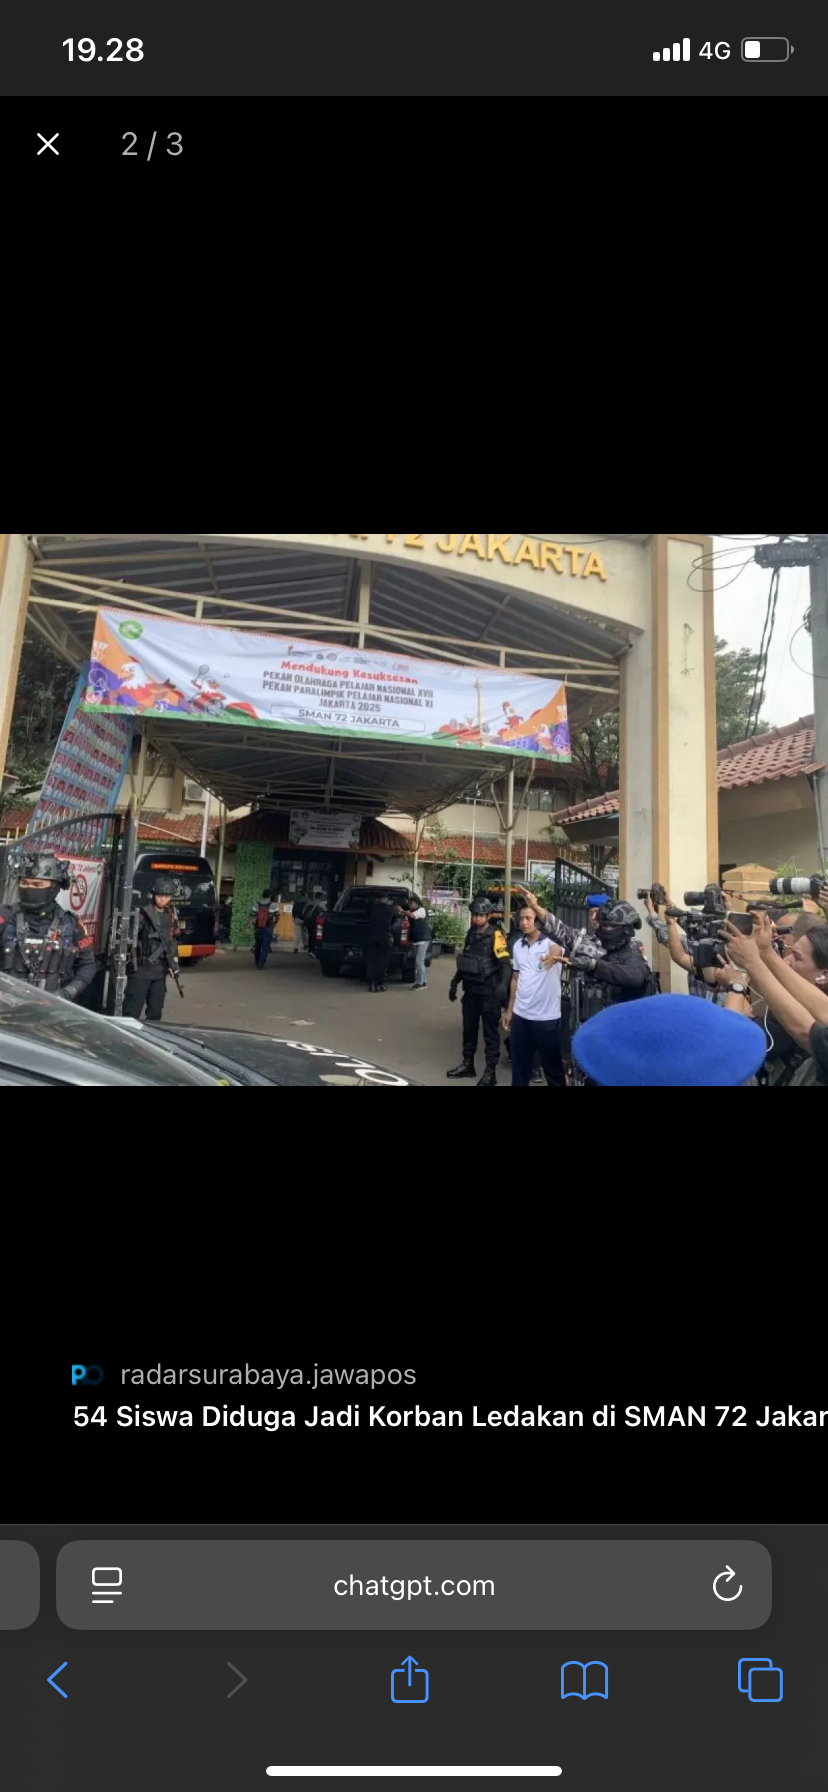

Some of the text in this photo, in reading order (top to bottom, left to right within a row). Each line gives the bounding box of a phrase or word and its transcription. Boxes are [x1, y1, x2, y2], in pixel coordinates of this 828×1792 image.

[436, 534, 607, 581] JAKARTA
[263, 671, 292, 682] PEKAN
[294, 675, 338, 688] OLAHRAGA
[340, 680, 375, 692] PELAJAR
[377, 685, 415, 696] NASIONAL
[281, 661, 349, 678] Mendukung
[353, 669, 418, 685] Kesuksesan
[262, 680, 433, 709] PEKAN PARALIMPIK PELAJAR NASIONAL XI
[319, 699, 381, 713] JAKARTA 2025
[298, 709, 400, 728] SMAN 72 JAKARTA
